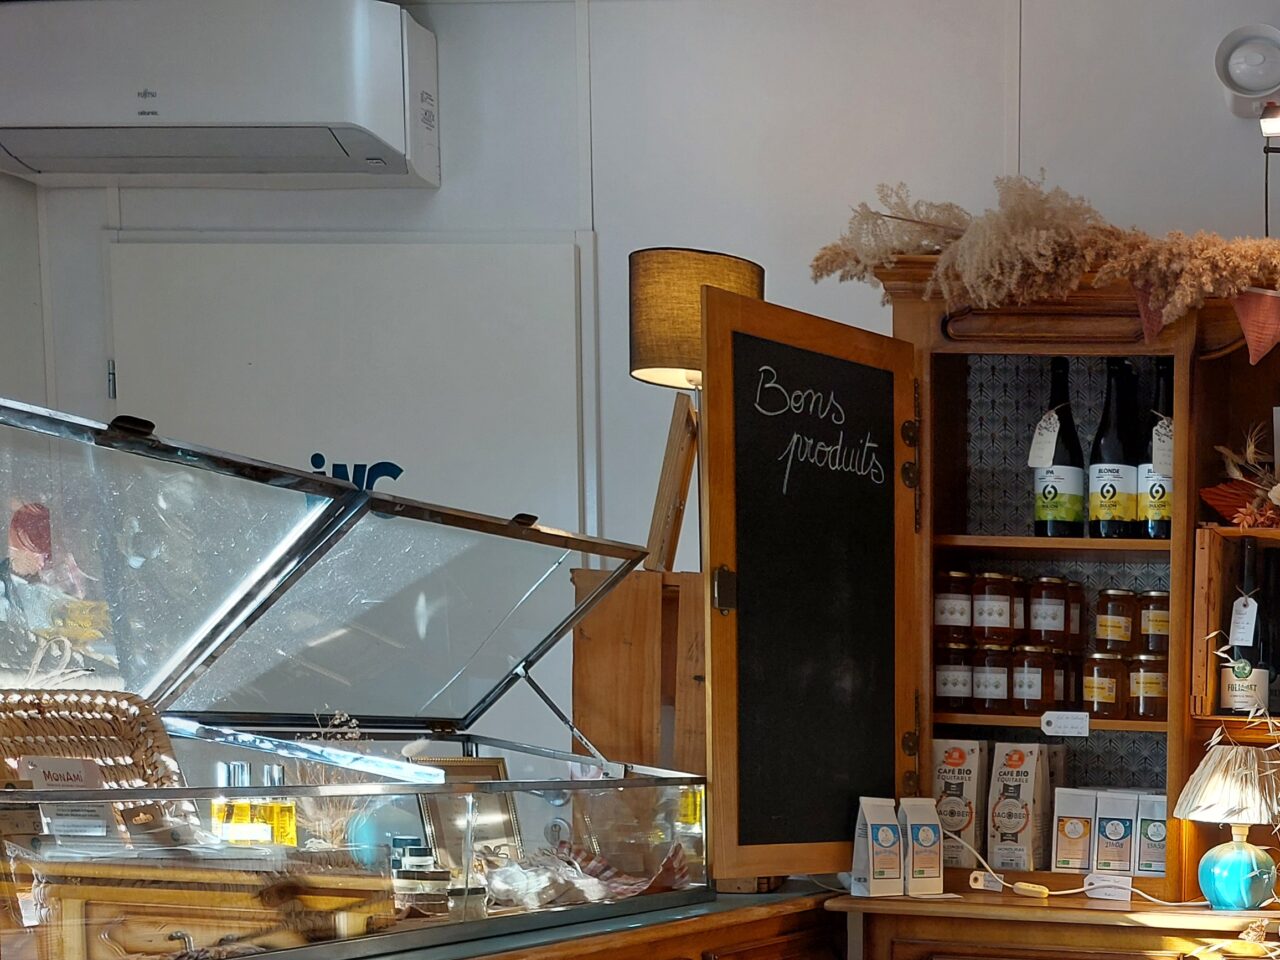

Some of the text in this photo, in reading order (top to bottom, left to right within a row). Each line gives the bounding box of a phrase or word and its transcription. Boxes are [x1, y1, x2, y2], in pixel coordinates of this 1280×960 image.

[754, 365, 845, 425] Bons
[778, 430, 885, 495] produits
[957, 768, 973, 776] BIO
[1015, 770, 1030, 778] BIO
